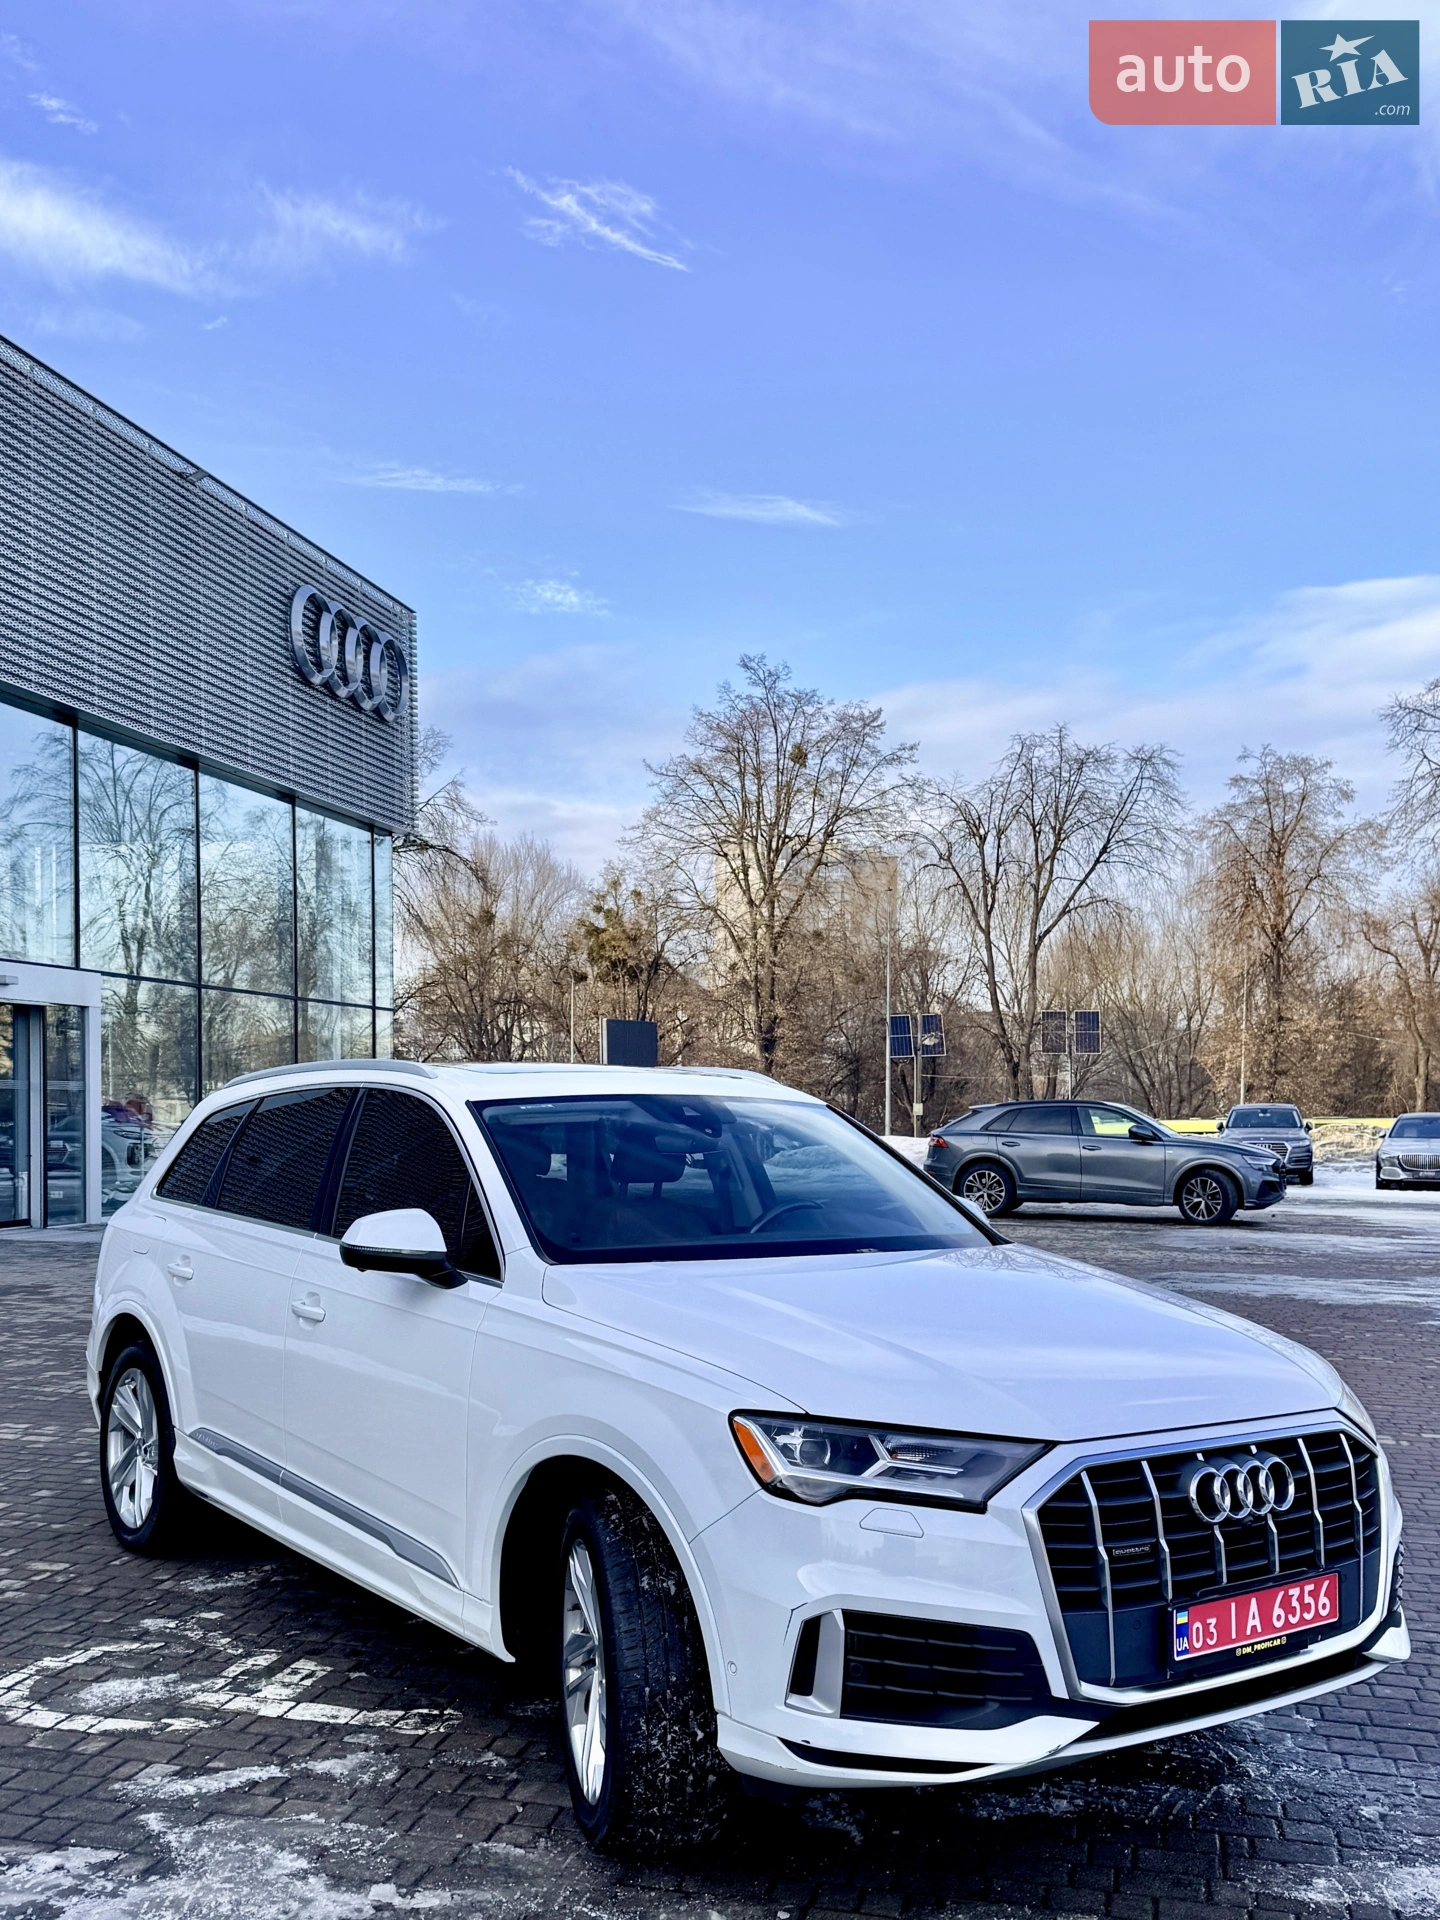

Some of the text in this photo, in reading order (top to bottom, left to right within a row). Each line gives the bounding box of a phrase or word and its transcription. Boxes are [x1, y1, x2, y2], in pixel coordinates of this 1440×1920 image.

[1192, 1617, 1218, 1649] 03
[1272, 1579, 1331, 1629] 6356
[1176, 1636, 1189, 1652] UA
